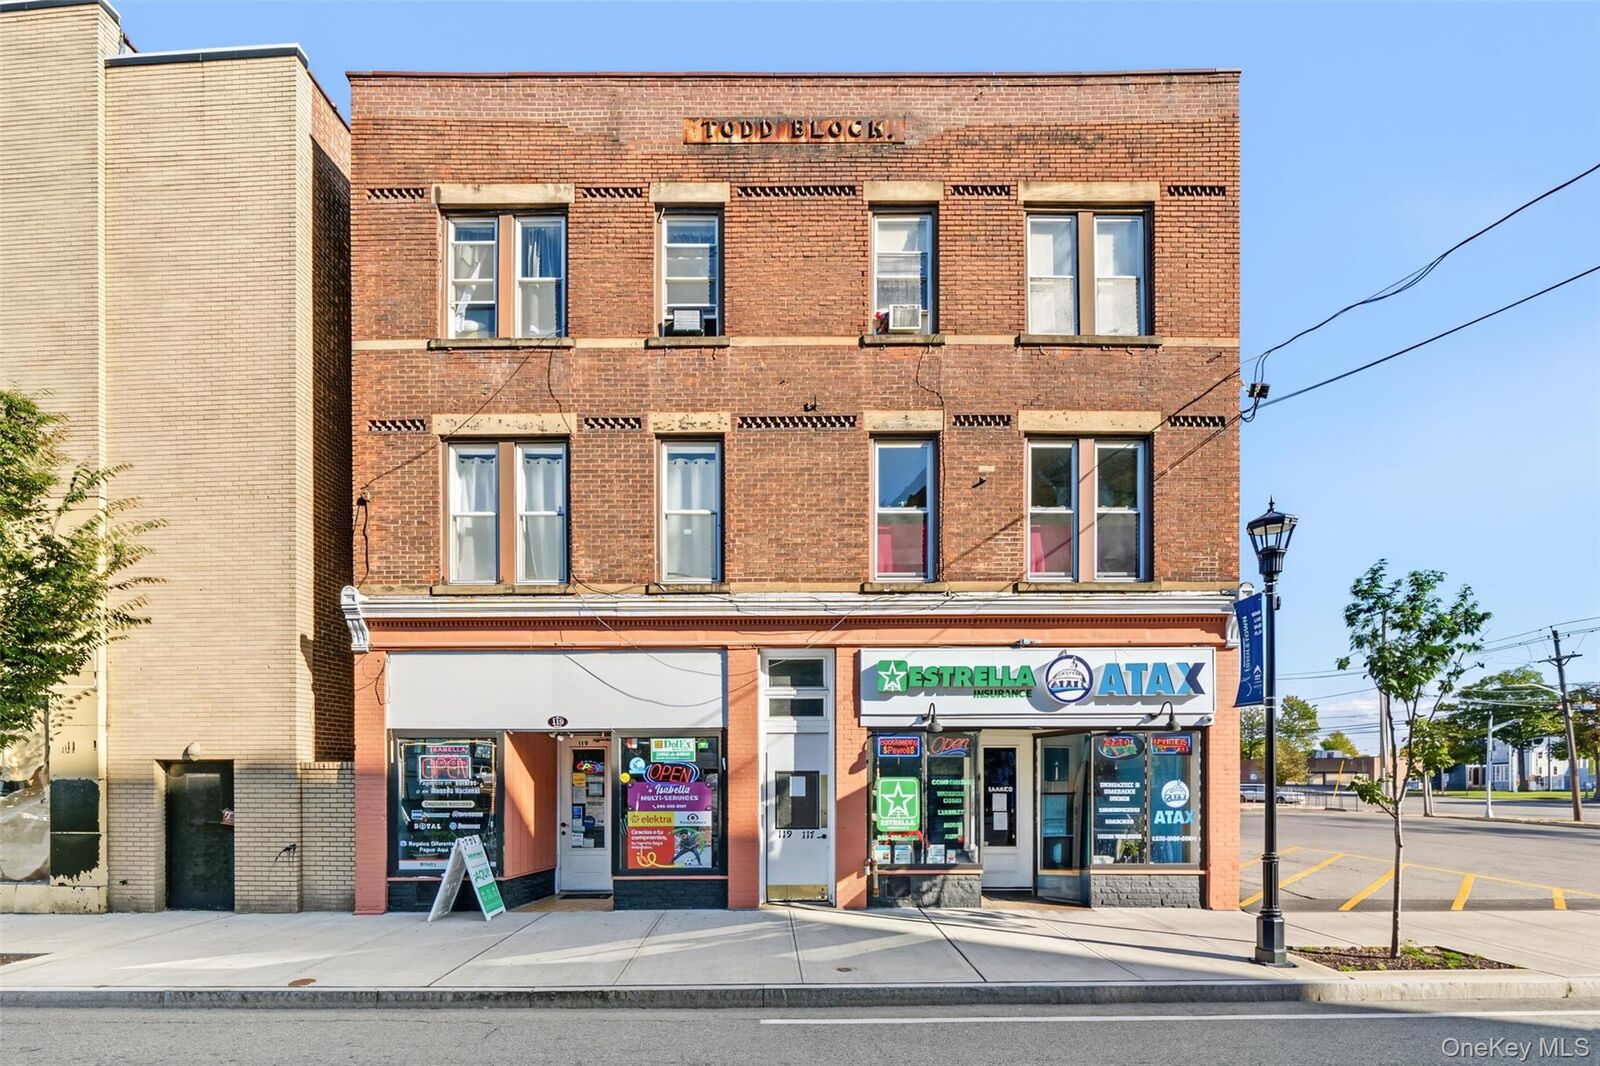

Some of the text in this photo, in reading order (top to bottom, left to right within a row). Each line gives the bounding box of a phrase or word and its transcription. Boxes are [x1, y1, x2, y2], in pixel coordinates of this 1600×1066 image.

[701, 120, 893, 139] TODD BLOCK.
[908, 665, 1036, 687] ESTRELLA
[1098, 662, 1206, 695] ATAX
[973, 689, 1032, 698] INSURANCE
[650, 763, 692, 783] OPEN
[655, 784, 690, 794] Isabella
[641, 815, 672, 824] elektra
[1154, 810, 1194, 824] ATAX
[778, 830, 815, 839] 119 117
